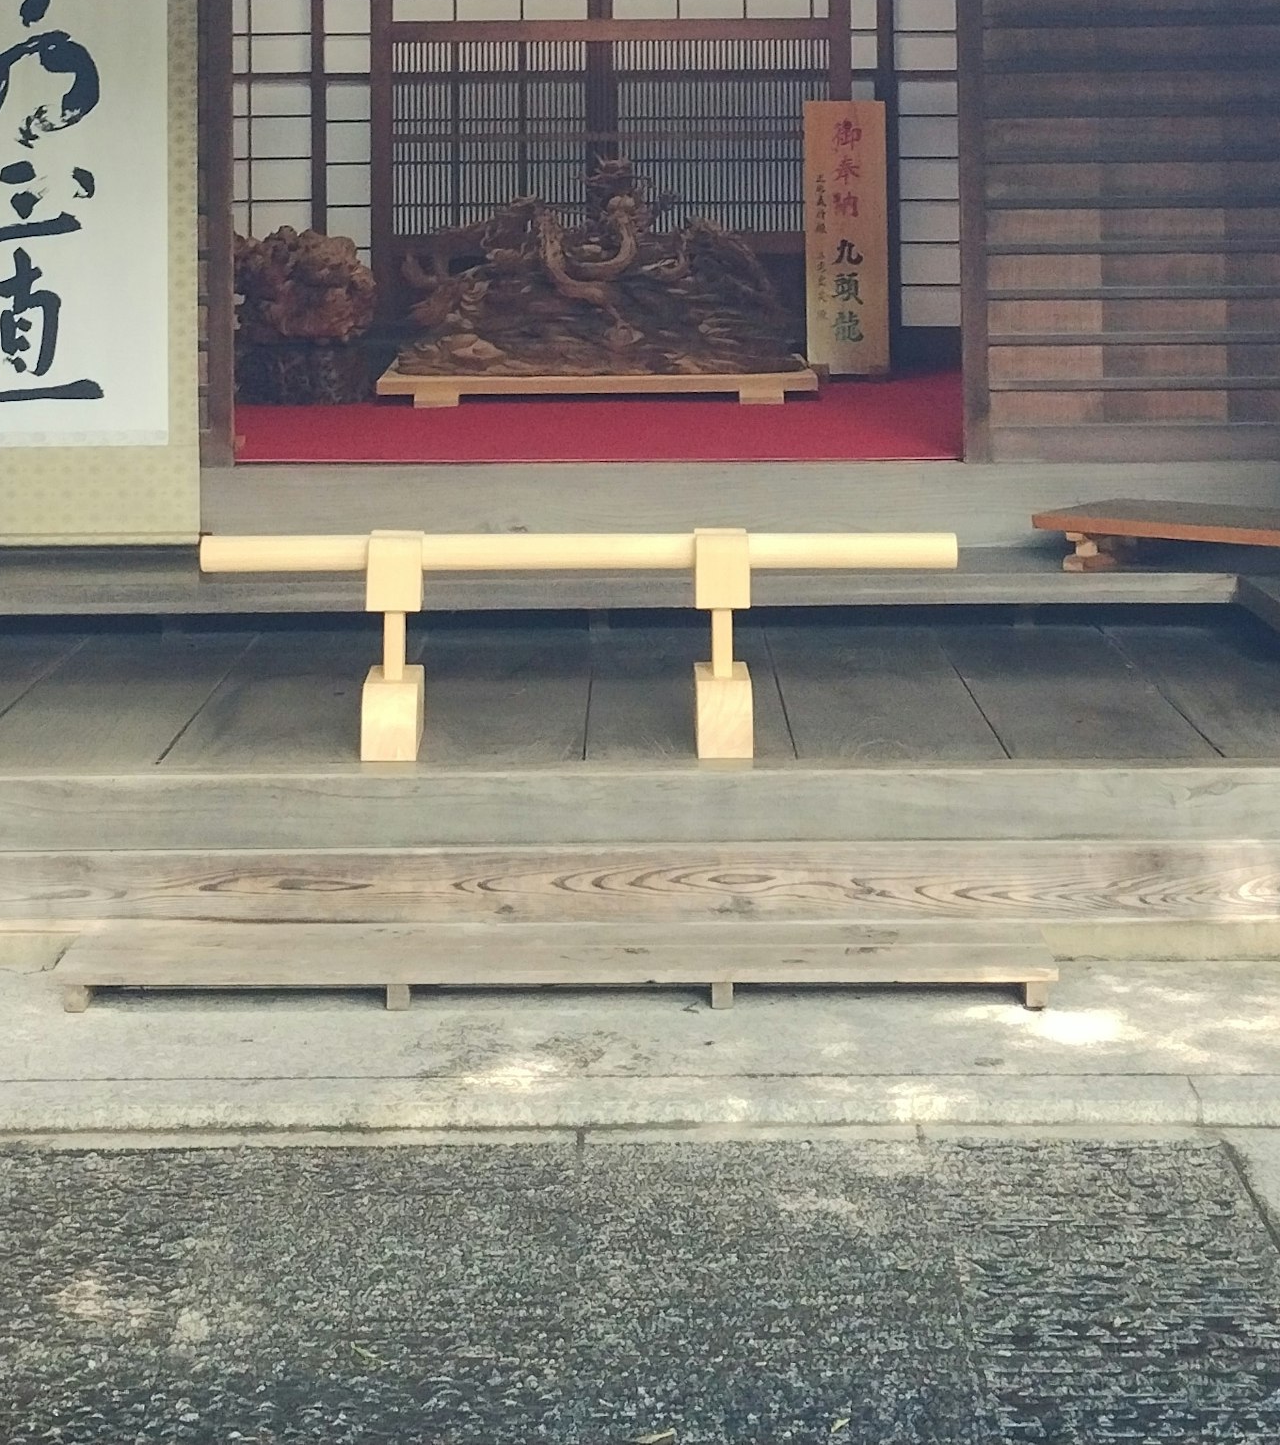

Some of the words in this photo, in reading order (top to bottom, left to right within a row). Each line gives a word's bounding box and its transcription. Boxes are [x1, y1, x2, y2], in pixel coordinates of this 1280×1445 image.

[831, 118, 863, 219] 御奉納
[831, 239, 865, 343] 九頭龍
